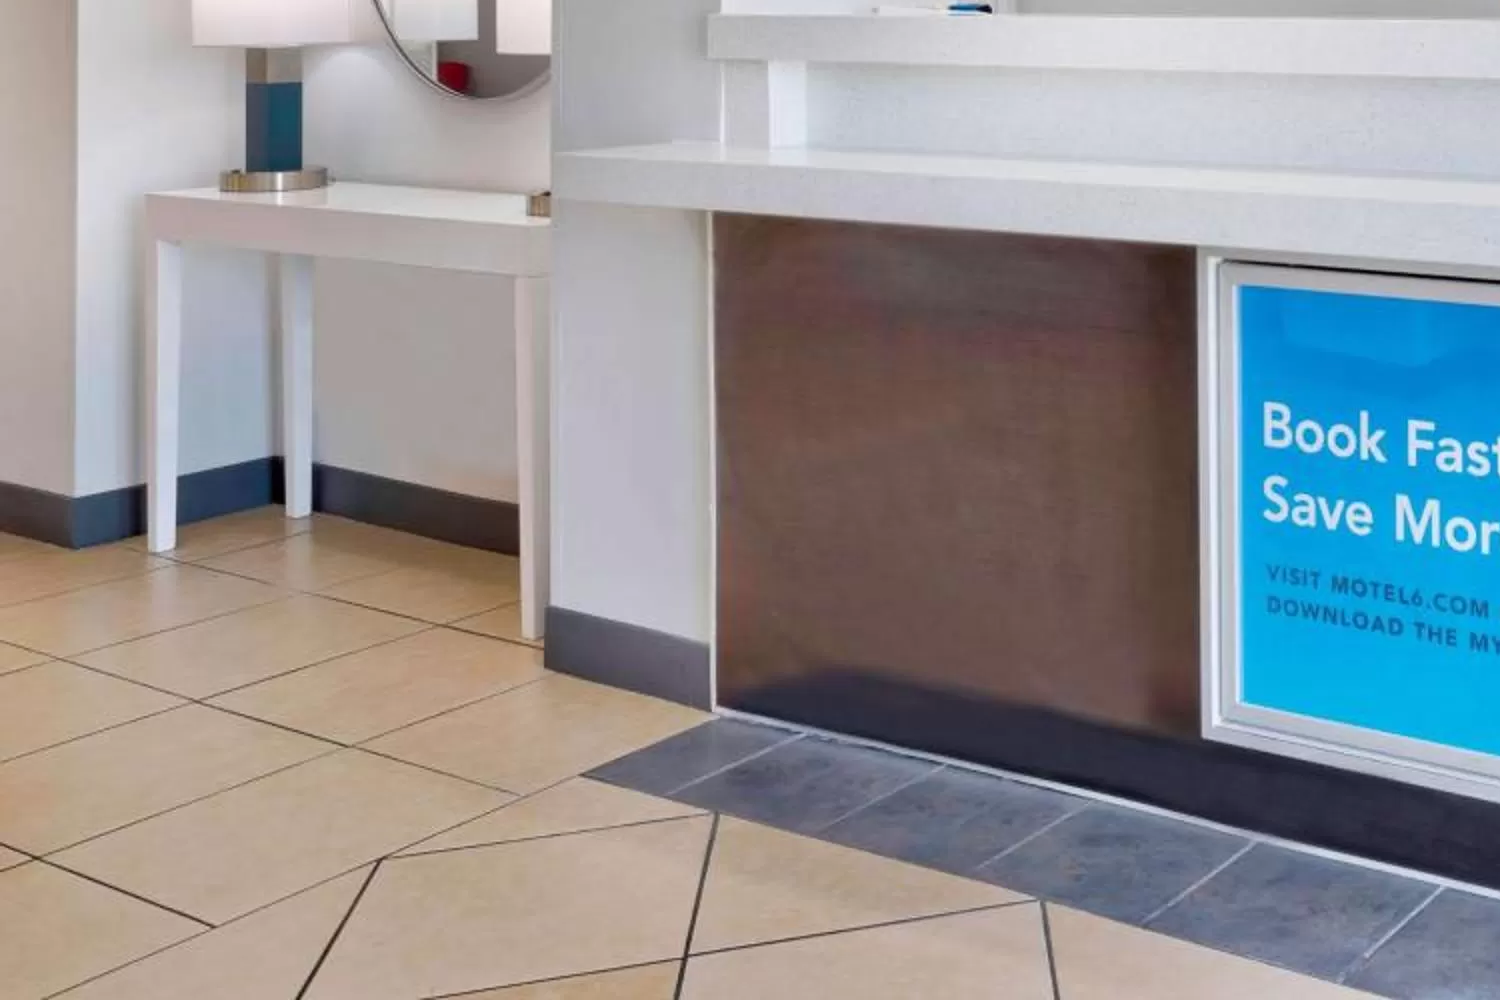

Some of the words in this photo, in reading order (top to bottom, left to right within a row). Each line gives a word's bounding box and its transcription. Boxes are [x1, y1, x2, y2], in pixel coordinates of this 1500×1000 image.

[1263, 401, 1388, 463] Book
[1263, 475, 1374, 536] Save
[1266, 563, 1322, 589] VISIT
[1331, 574, 1490, 620] MOTEL6.COM
[1266, 595, 1406, 637] DOWNLOAD
[1413, 620, 1458, 648] THE
